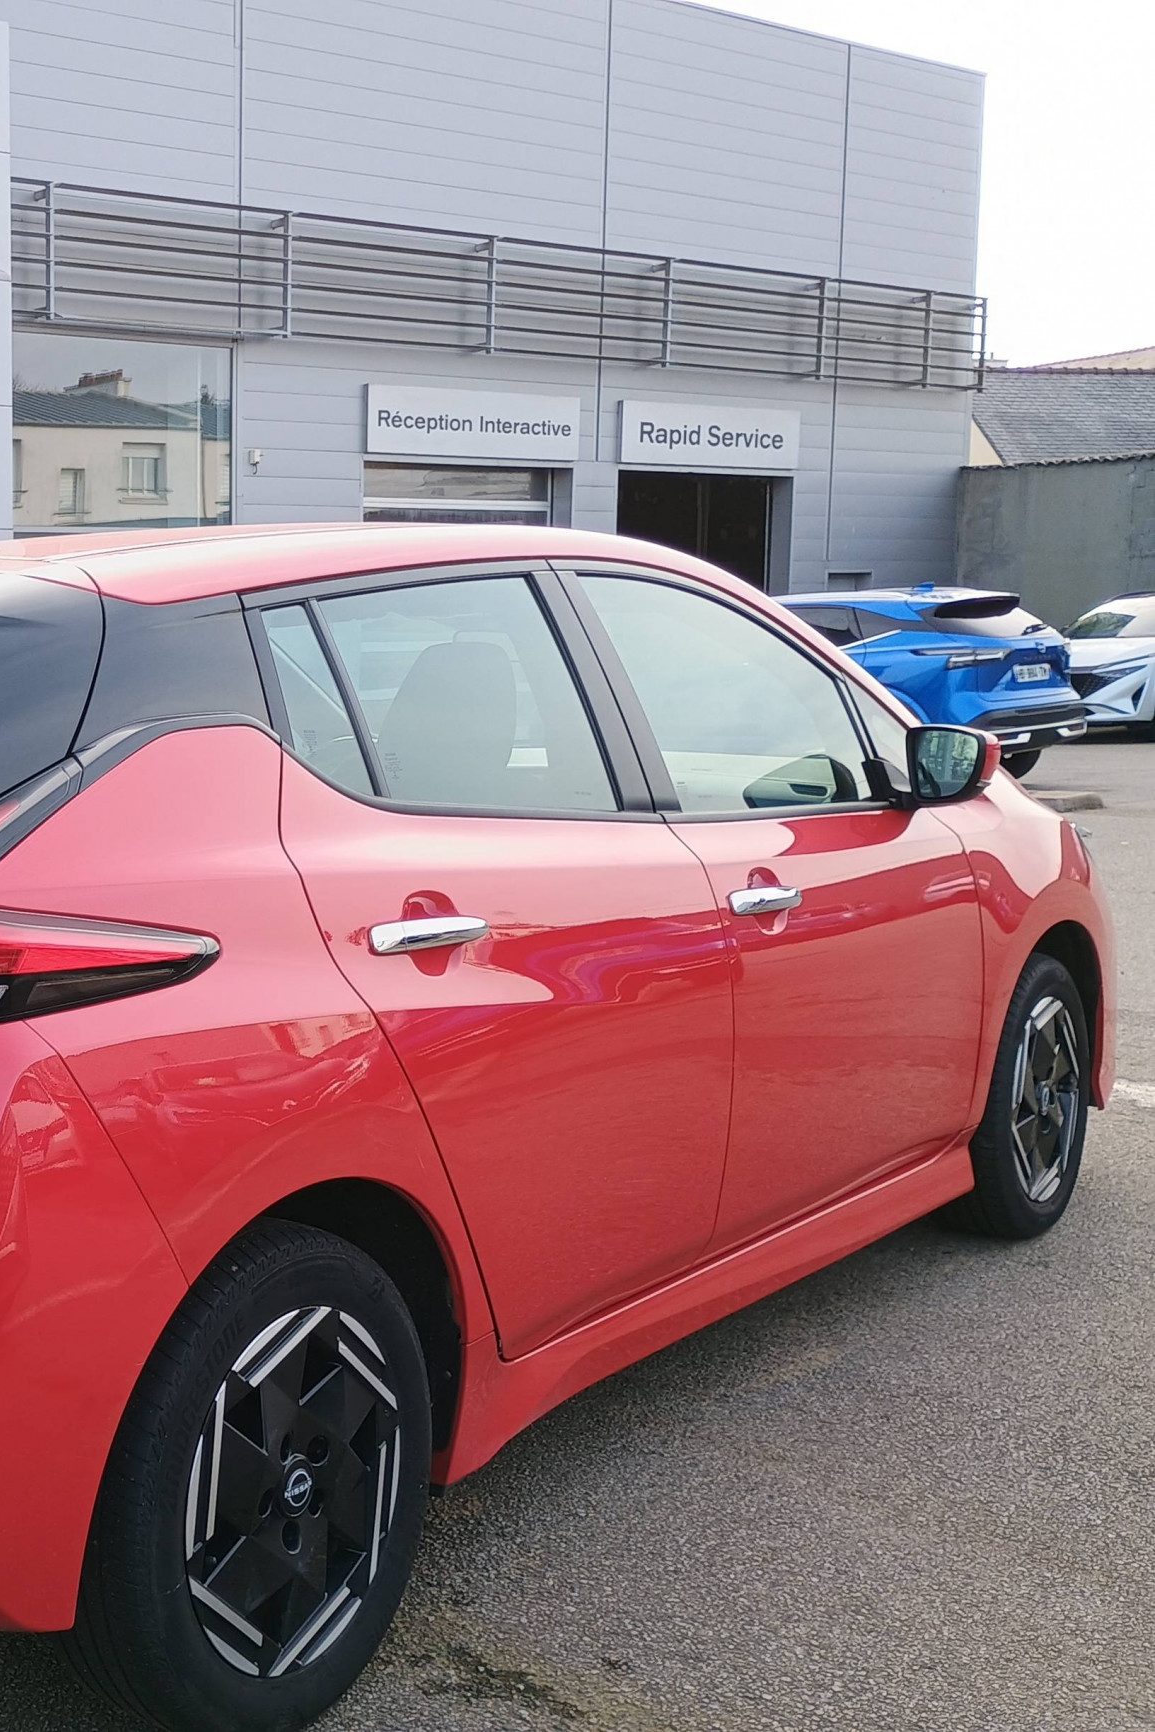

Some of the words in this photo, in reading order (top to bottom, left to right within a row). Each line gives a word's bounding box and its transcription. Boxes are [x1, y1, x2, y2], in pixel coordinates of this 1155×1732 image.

[377, 409, 473, 434] Réception
[479, 416, 572, 437] Interactive
[639, 421, 701, 449] Rapid
[707, 425, 784, 449] Service
[284, 1478, 313, 1499] NISSAN
